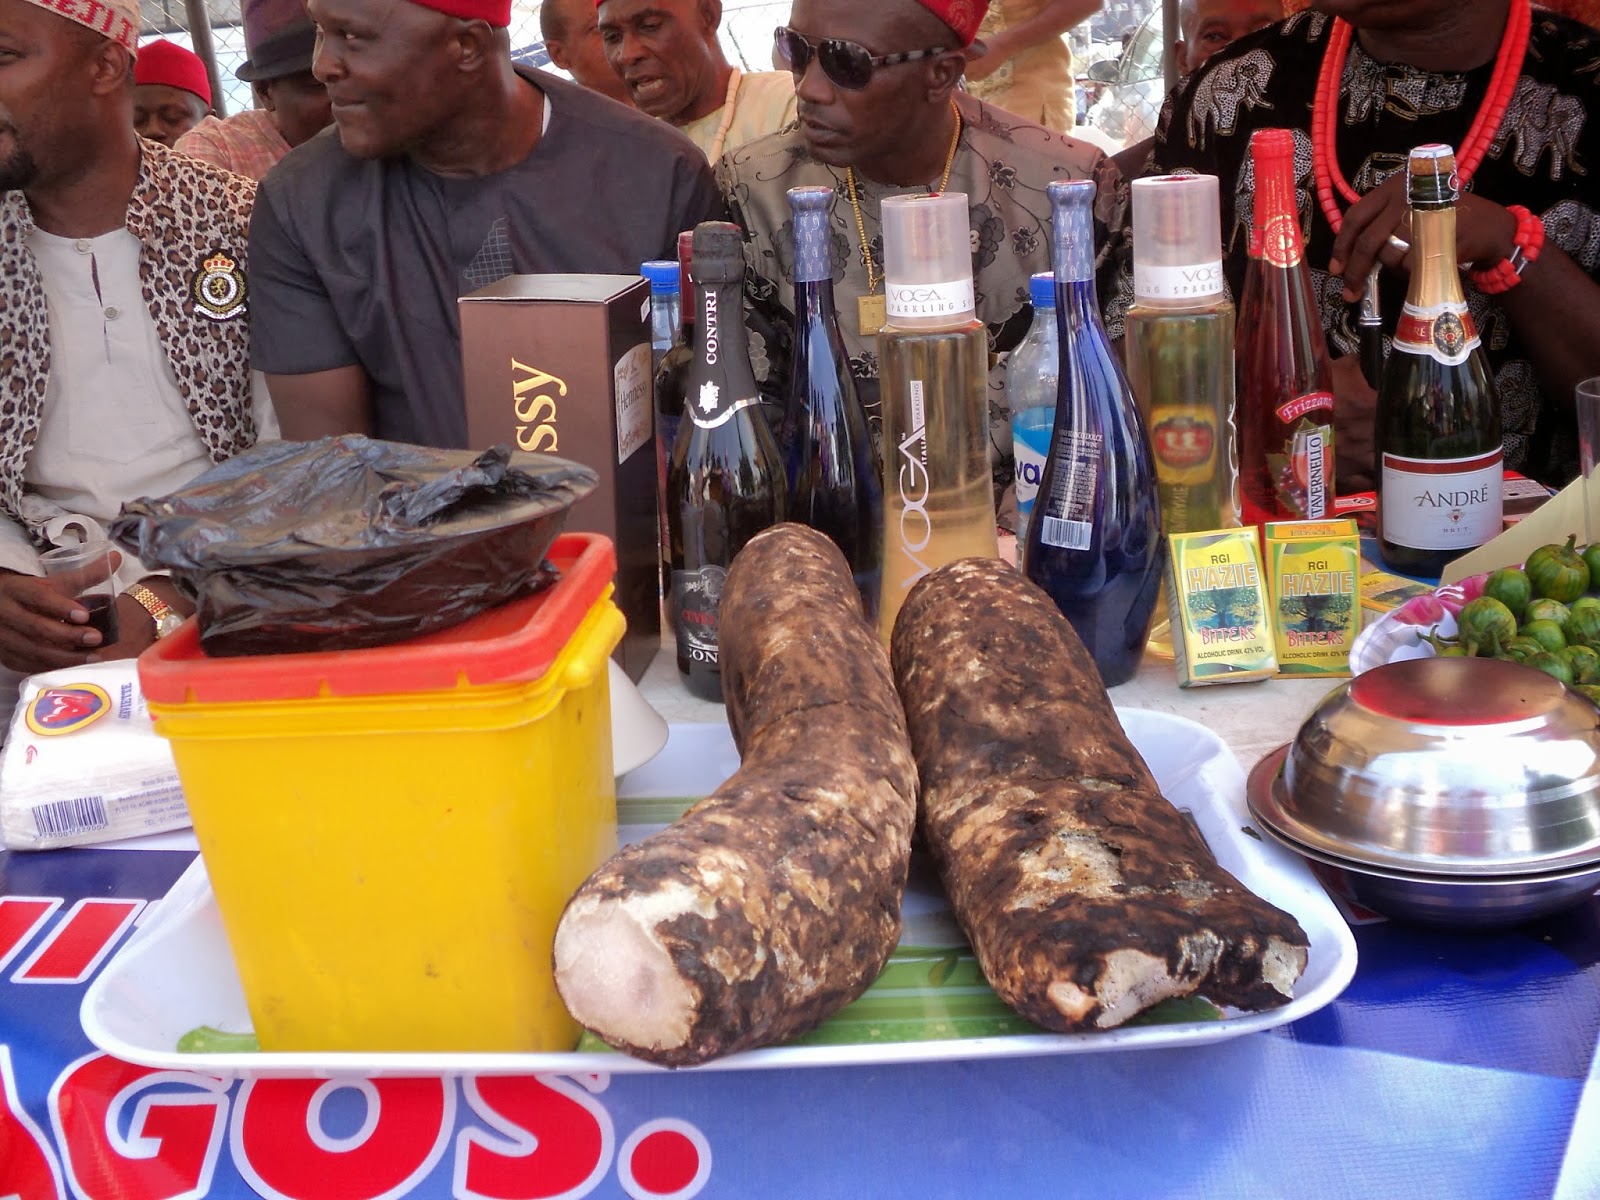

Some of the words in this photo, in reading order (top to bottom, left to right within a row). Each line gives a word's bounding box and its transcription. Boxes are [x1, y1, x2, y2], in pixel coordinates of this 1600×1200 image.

[891, 289, 942, 302] VOGA
[705, 290, 718, 365] CONTRI
[511, 357, 567, 452] ssy
[1086, 433, 1103, 441] DOLCE
[1310, 436, 1323, 517] TAVERNELLO
[898, 424, 932, 588] VOGA
[1414, 483, 1488, 507] ANDRÉ
[1211, 553, 1230, 564] RGI
[1308, 560, 1328, 570] RGI
[1188, 562, 1258, 592] HAZIE
[1282, 571, 1354, 597] HAZIE
[1200, 625, 1256, 645] BITTERS
[1288, 630, 1344, 647] BITTERS
[1197, 650, 1226, 659] ALCOHOLIC
[0, 1044, 712, 1200] GOS.
